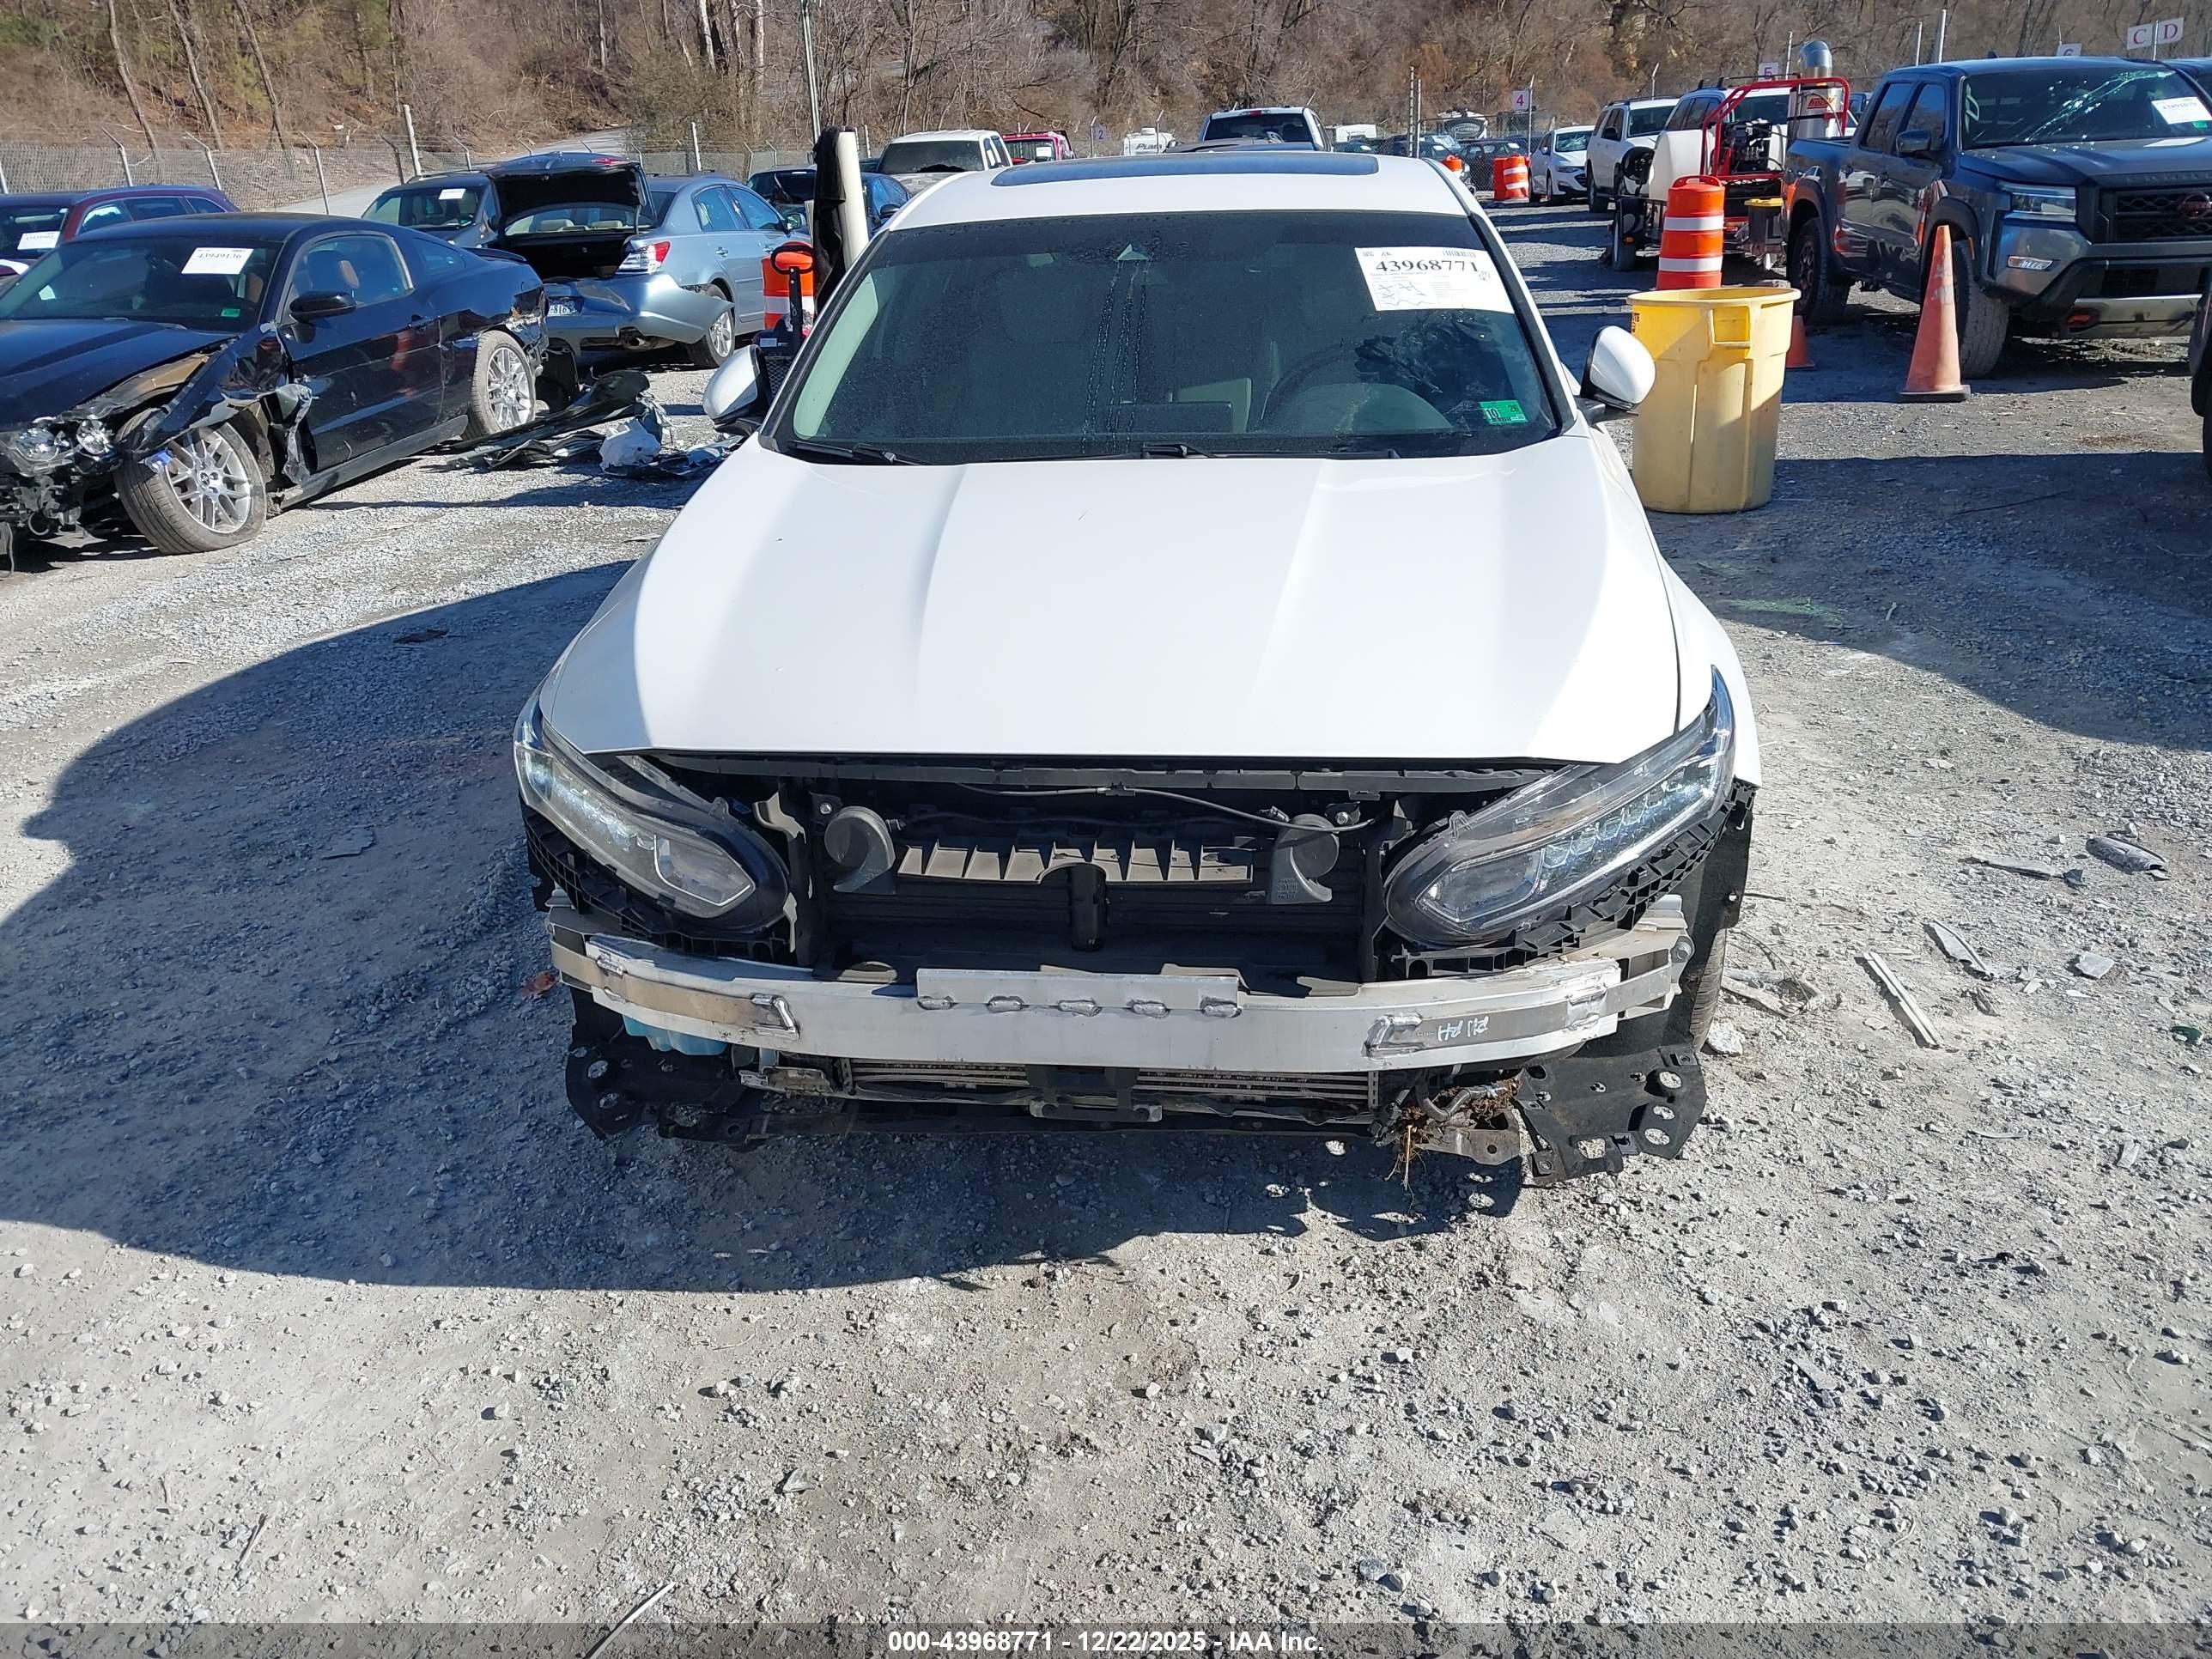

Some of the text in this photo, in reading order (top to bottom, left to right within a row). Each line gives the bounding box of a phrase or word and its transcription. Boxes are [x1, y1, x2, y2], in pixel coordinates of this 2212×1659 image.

[2133, 28, 2148, 45] C
[2163, 23, 2179, 40] D
[1516, 94, 1524, 106] 4
[1098, 130, 1103, 140] 2
[1376, 259, 1479, 272] 43968771
